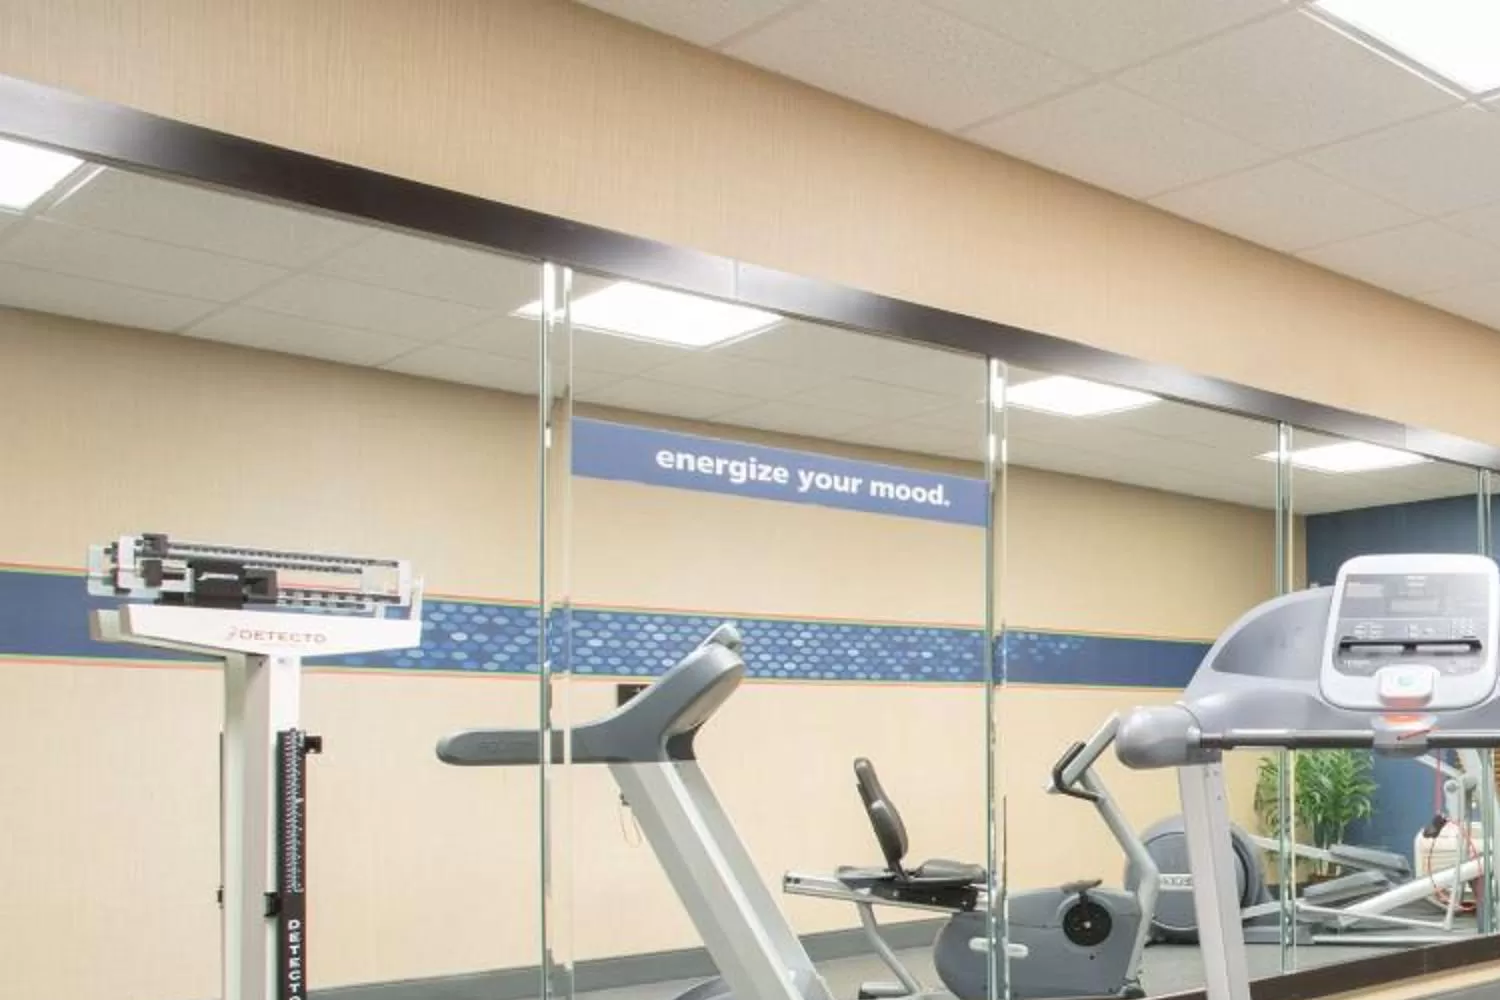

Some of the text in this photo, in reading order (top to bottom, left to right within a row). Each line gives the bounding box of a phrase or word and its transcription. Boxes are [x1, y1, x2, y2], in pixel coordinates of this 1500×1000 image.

[656, 449, 952, 507] energize your mood.
[239, 629, 327, 644] DETECTO
